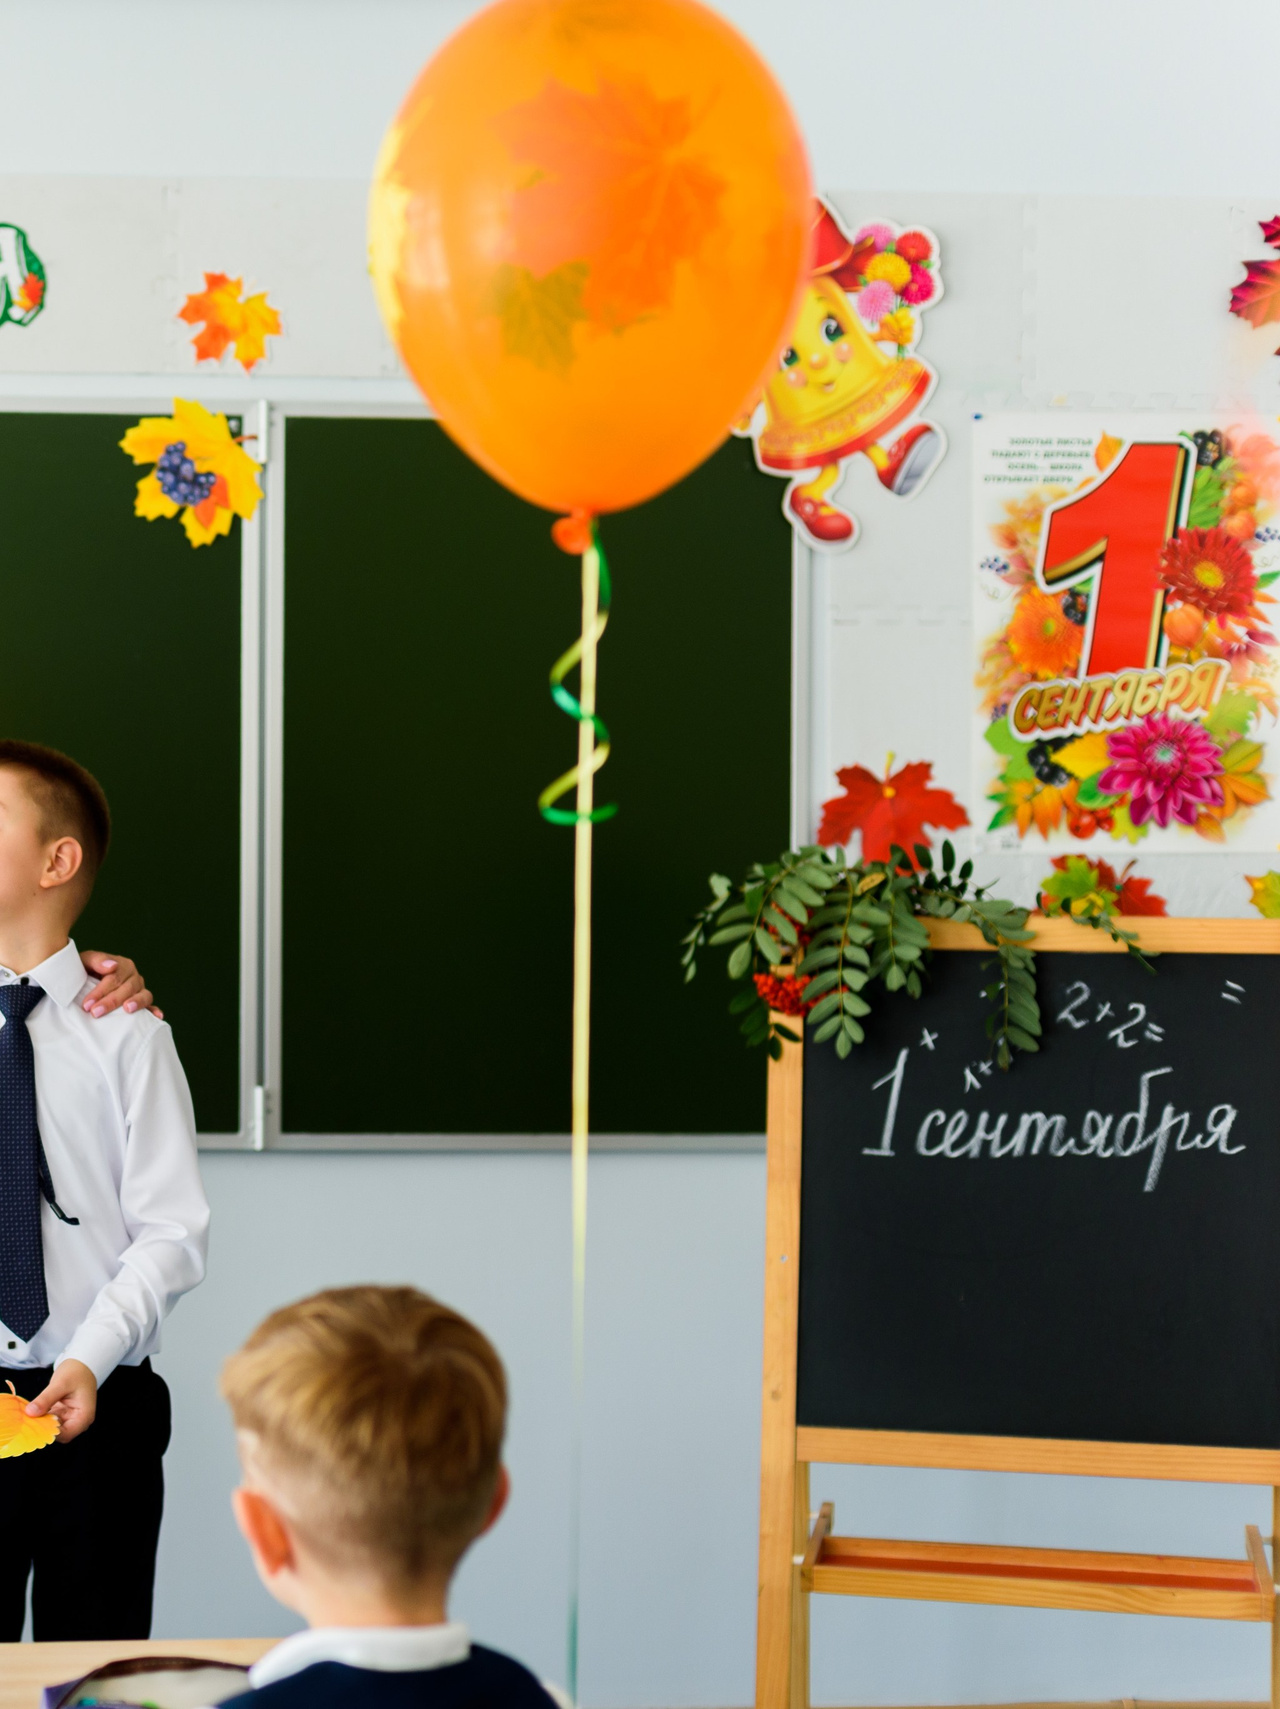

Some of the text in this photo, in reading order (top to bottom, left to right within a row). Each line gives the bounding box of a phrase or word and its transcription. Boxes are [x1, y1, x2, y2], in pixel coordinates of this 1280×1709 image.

[1041, 442, 1190, 678] 1
[1013, 662, 1224, 735] СЕНТЯБРЯ
[861, 1047, 1247, 1192] 1 сентября
